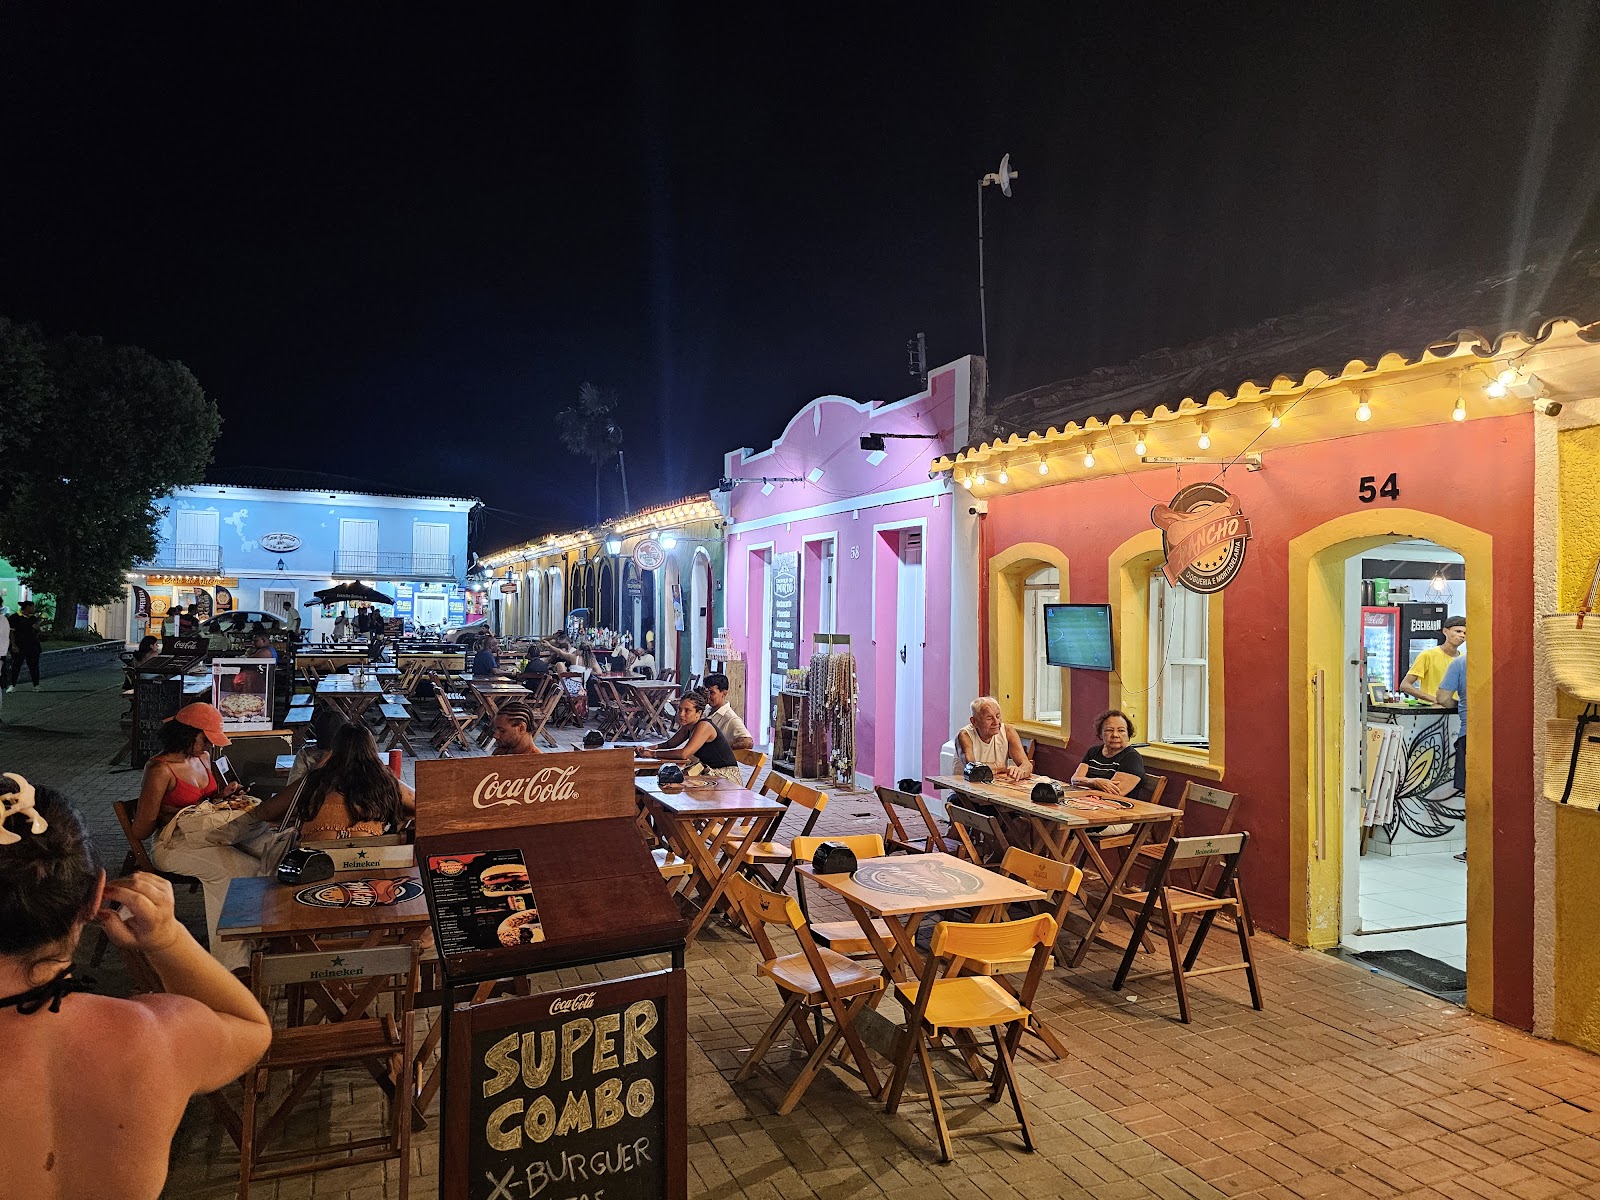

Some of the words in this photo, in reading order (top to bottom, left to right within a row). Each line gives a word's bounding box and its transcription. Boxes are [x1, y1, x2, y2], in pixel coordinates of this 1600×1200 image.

[1358, 473, 1400, 503] 54
[1175, 518, 1240, 568] RANCHO
[1186, 571, 1212, 586] DOGUERIA
[1217, 541, 1241, 583] MORTADELARIA
[1410, 619, 1442, 632] EISENBAHN
[173, 640, 198, 650] Coca-Cola
[342, 860, 381, 869] Heineken
[1194, 848, 1220, 856] Heineken
[309, 966, 364, 979] Heineken
[549, 991, 597, 1016] Coca-Cola
[483, 1000, 659, 1098] SUPER
[486, 1078, 655, 1151] COMBO
[485, 1136, 652, 1200] X-BURGUER
